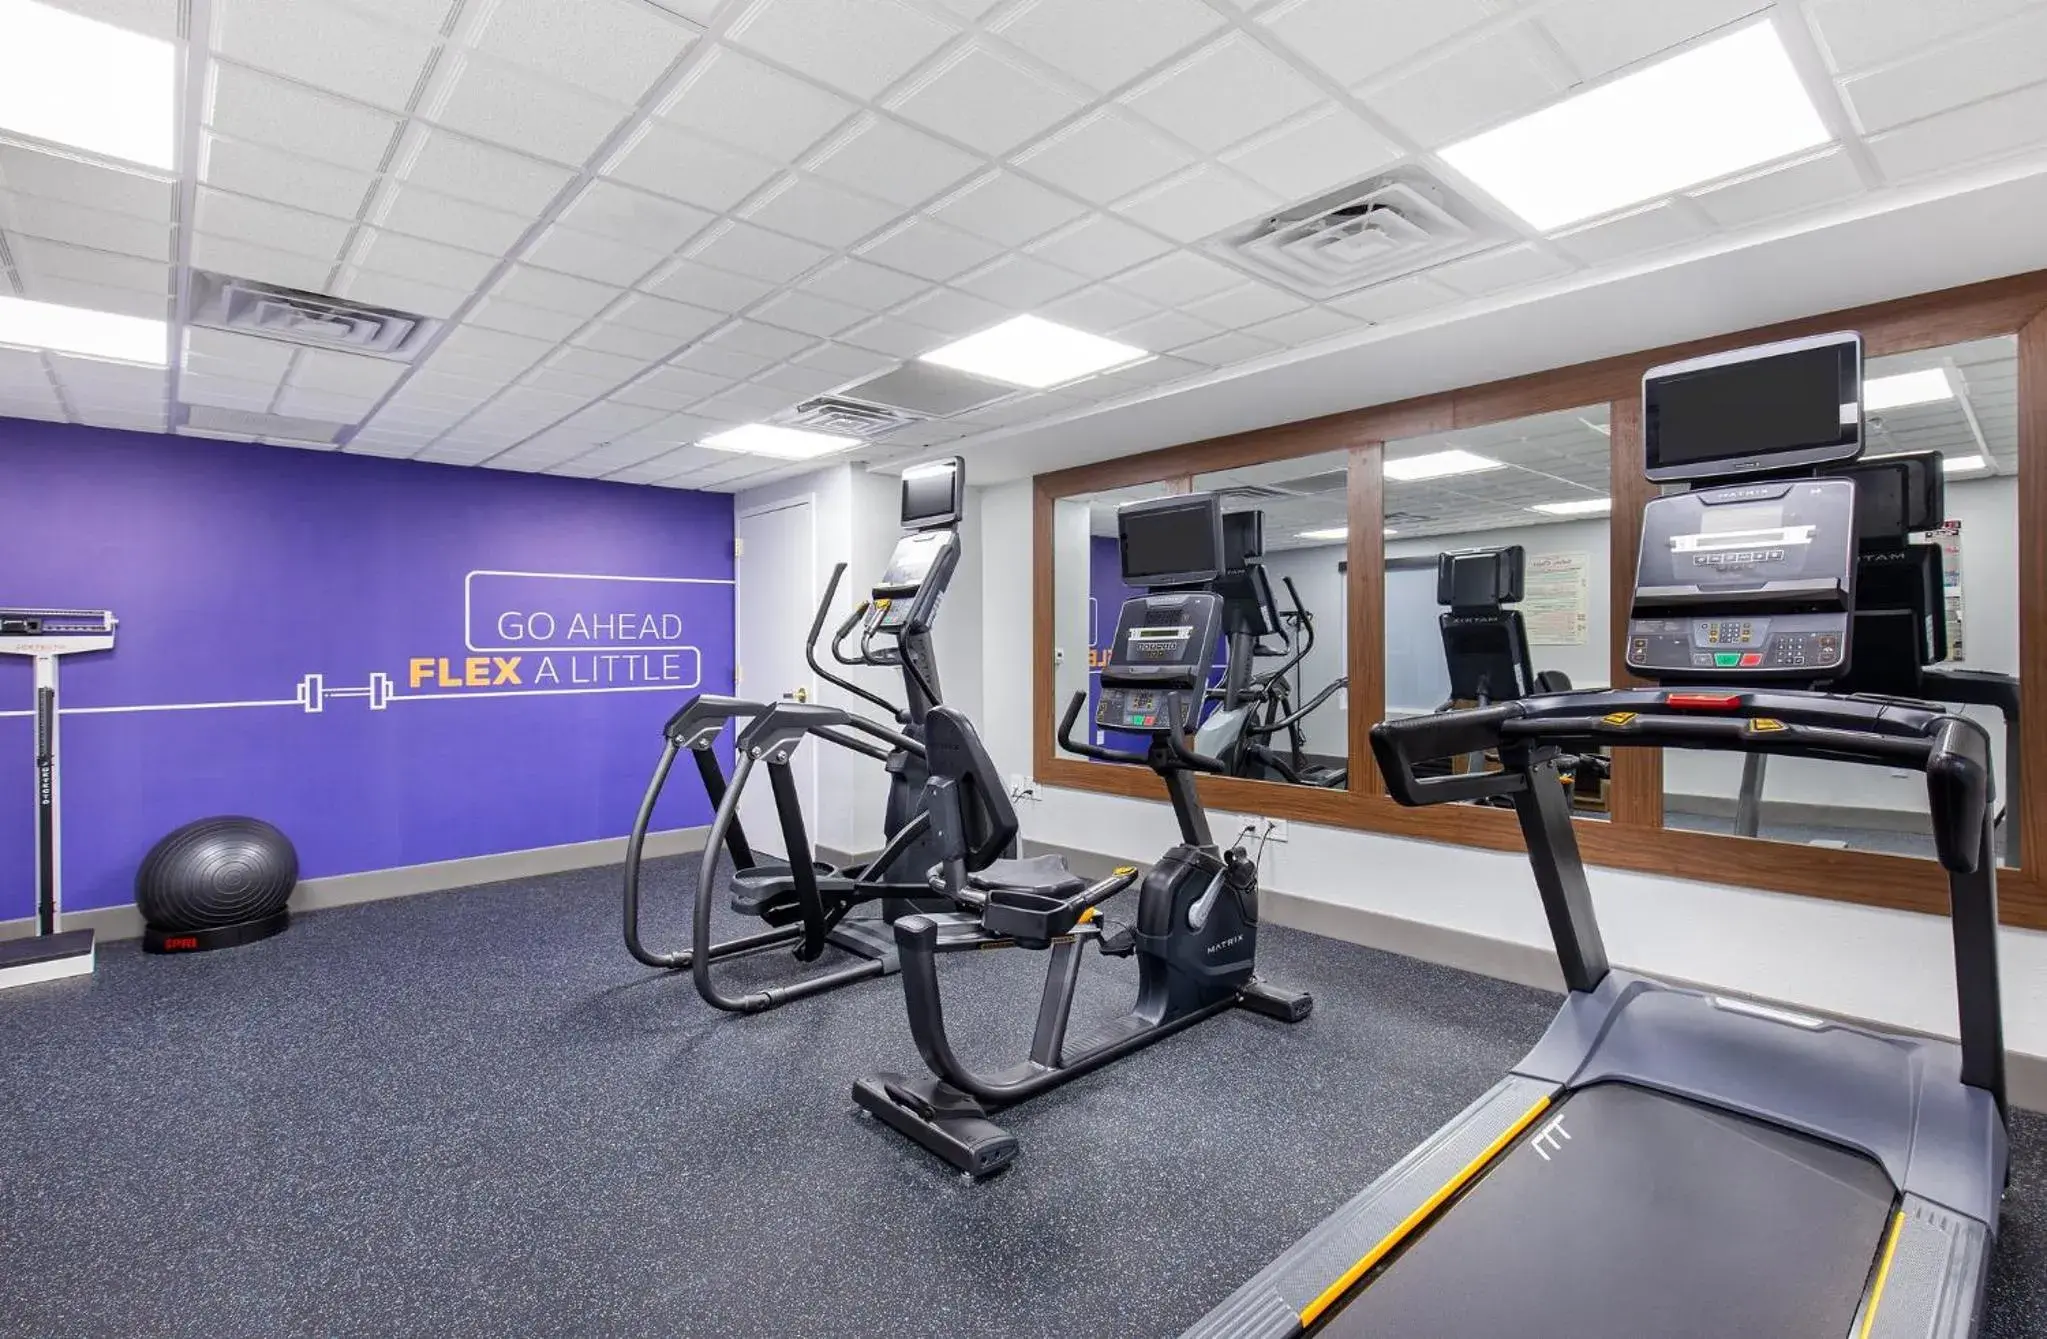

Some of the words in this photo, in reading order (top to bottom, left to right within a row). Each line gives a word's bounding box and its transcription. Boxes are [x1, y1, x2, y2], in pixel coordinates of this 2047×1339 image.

[498, 611, 554, 640] GO
[567, 612, 682, 640] AHEAD
[409, 656, 522, 688] FLEX
[534, 656, 559, 684] A
[572, 654, 680, 683] LITTLE
[1207, 934, 1244, 954] MATRIX
